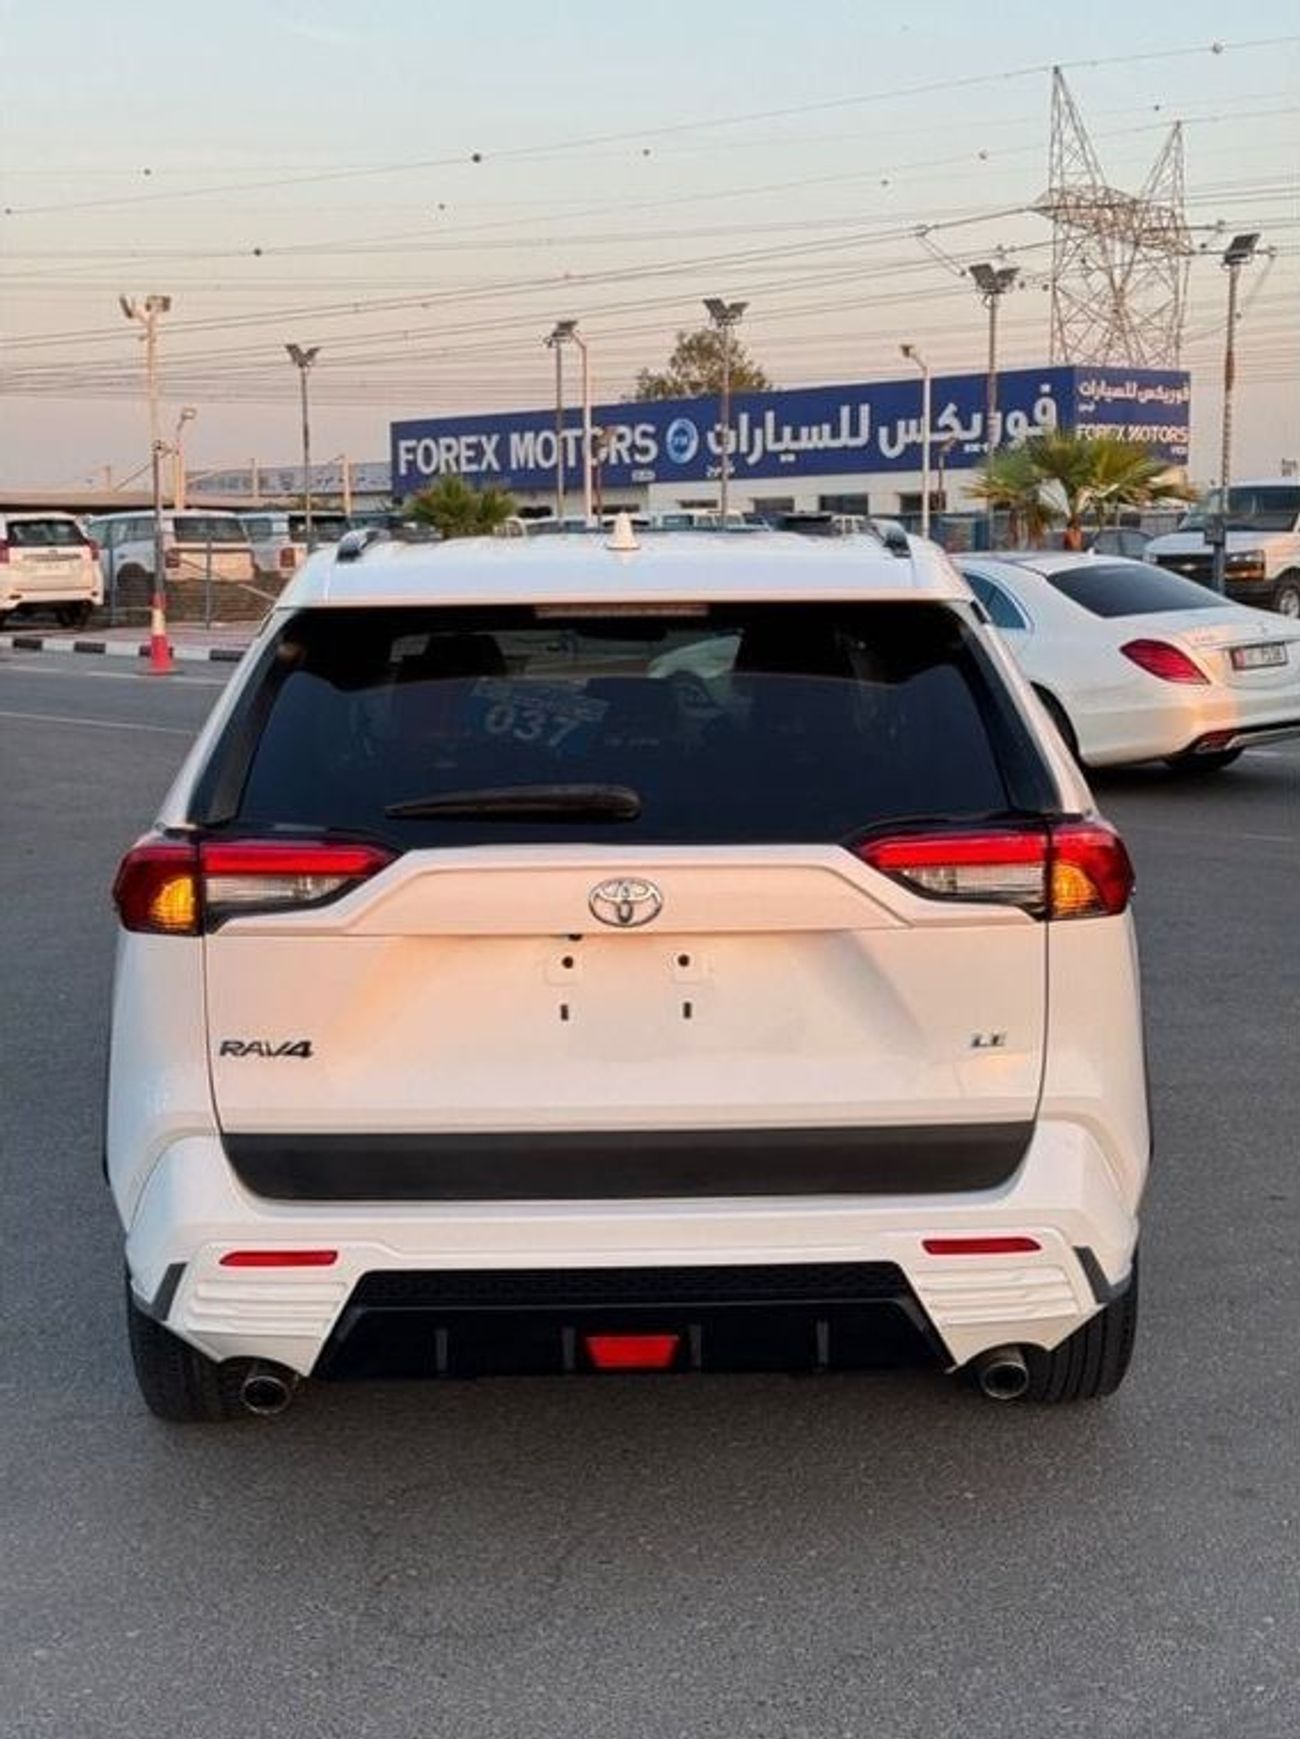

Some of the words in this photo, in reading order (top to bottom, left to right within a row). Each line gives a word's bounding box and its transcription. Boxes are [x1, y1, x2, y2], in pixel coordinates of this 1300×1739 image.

[398, 433, 500, 476] FOREX
[509, 423, 658, 470] MOTORS
[707, 403, 870, 465] للسيارات
[219, 1040, 313, 1058] RAV4
